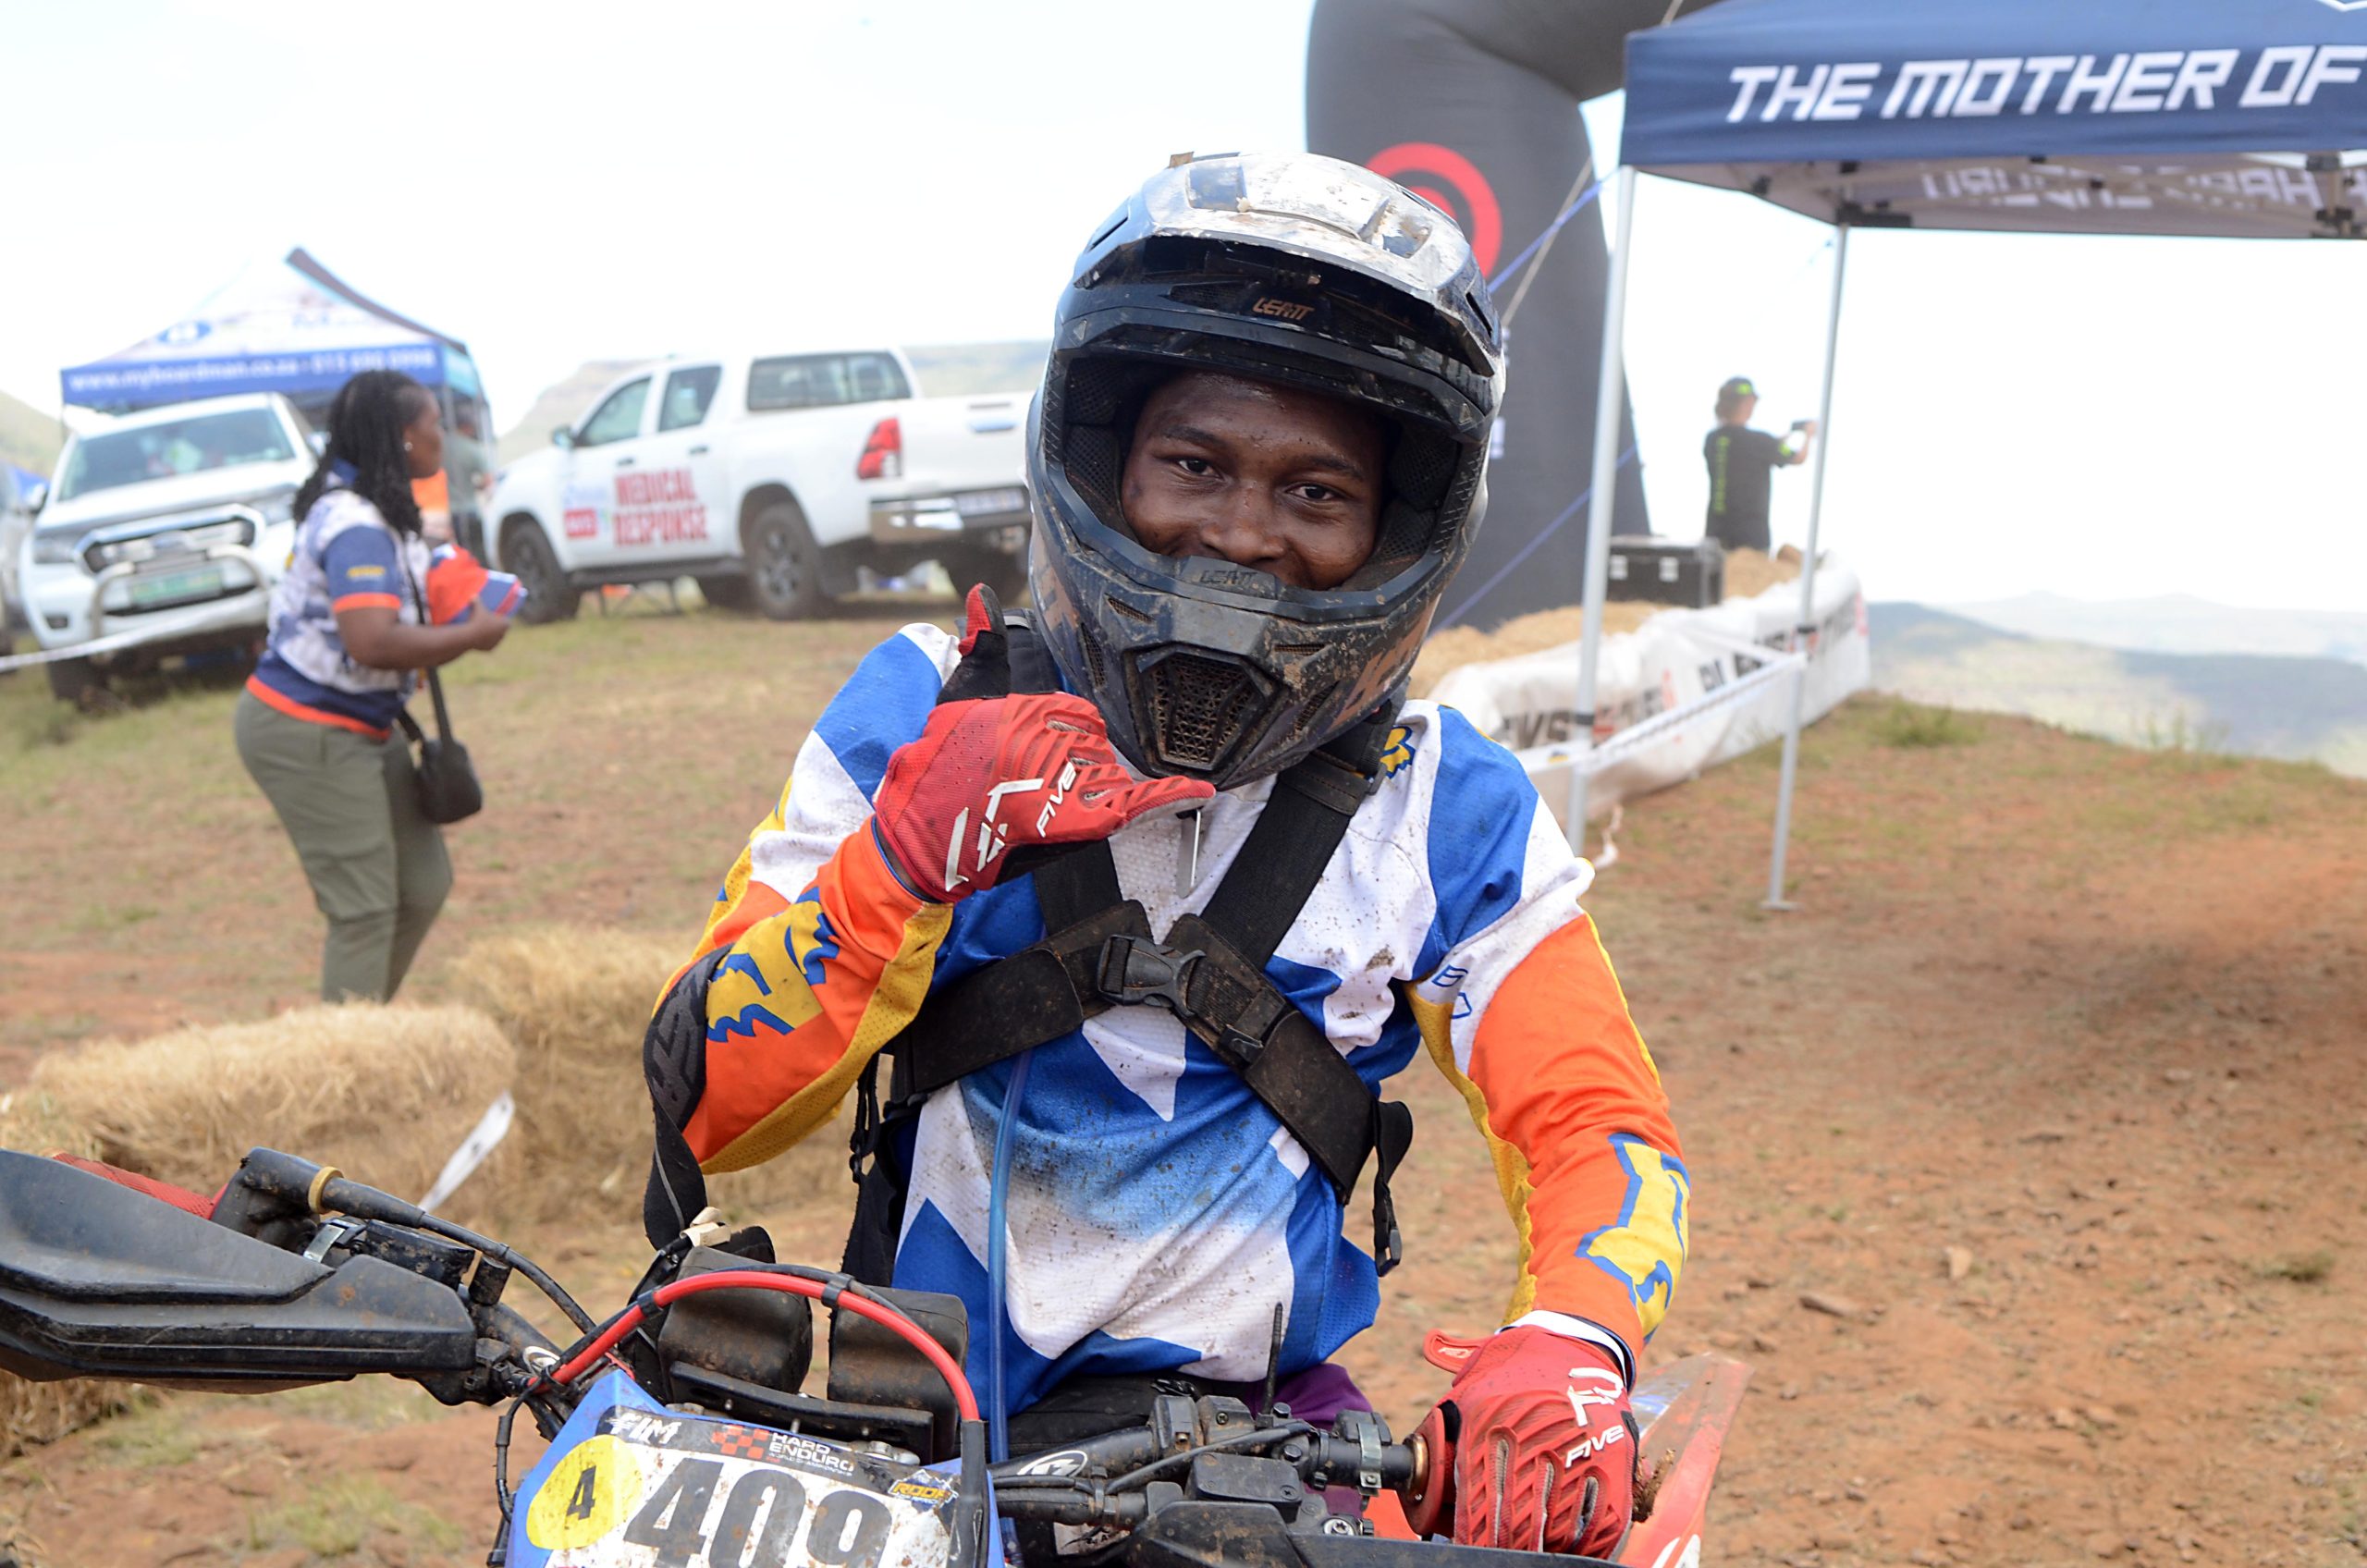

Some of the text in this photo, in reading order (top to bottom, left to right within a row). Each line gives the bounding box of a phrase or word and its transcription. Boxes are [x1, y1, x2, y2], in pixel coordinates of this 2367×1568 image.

[1727, 44, 2367, 123] THE MOTHER OF
[1252, 297, 1315, 321] LEATT
[615, 470, 697, 505] MEDICAL
[613, 505, 709, 545] RESPONSE
[1036, 762, 1076, 837] FIVE
[607, 1413, 682, 1445] FIM
[772, 1432, 831, 1455] HARD
[1565, 1425, 1625, 1468] FIVE
[769, 1441, 854, 1473] ENDURO
[566, 1466, 597, 1521] 4
[623, 1457, 893, 1568] 409
